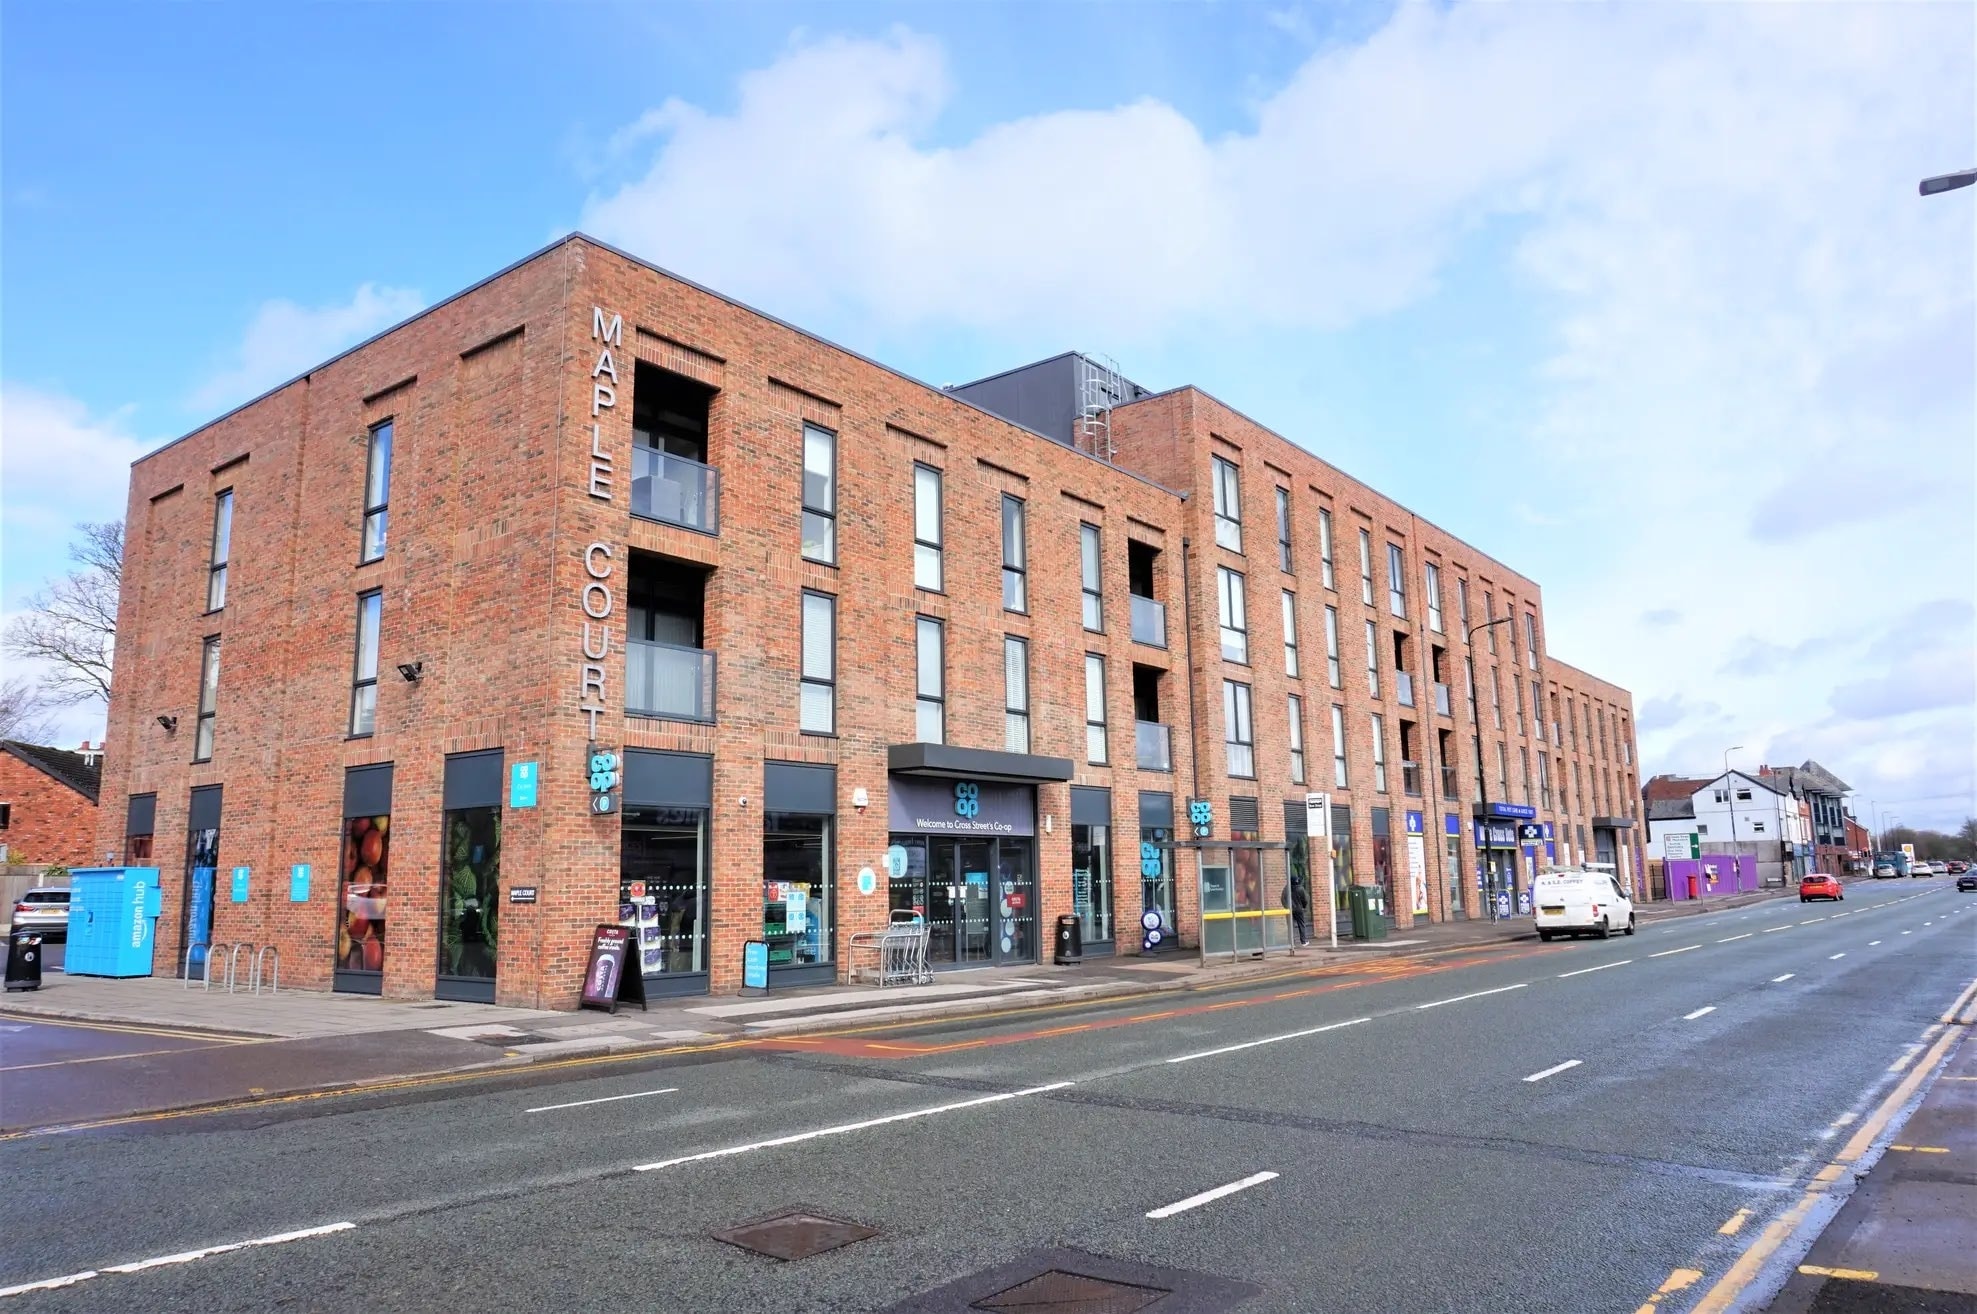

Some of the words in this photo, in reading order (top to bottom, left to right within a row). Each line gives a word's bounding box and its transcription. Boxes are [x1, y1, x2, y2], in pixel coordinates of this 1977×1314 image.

[588, 305, 623, 500] MAPLE
[580, 542, 613, 742] COURT
[917, 818, 946, 829] Welcome
[947, 821, 953, 829] to
[954, 820, 971, 829] Cross
[972, 821, 993, 830] Street's
[994, 821, 1012, 832] Co-op
[132, 881, 146, 904] hub
[132, 906, 144, 948] amazon
